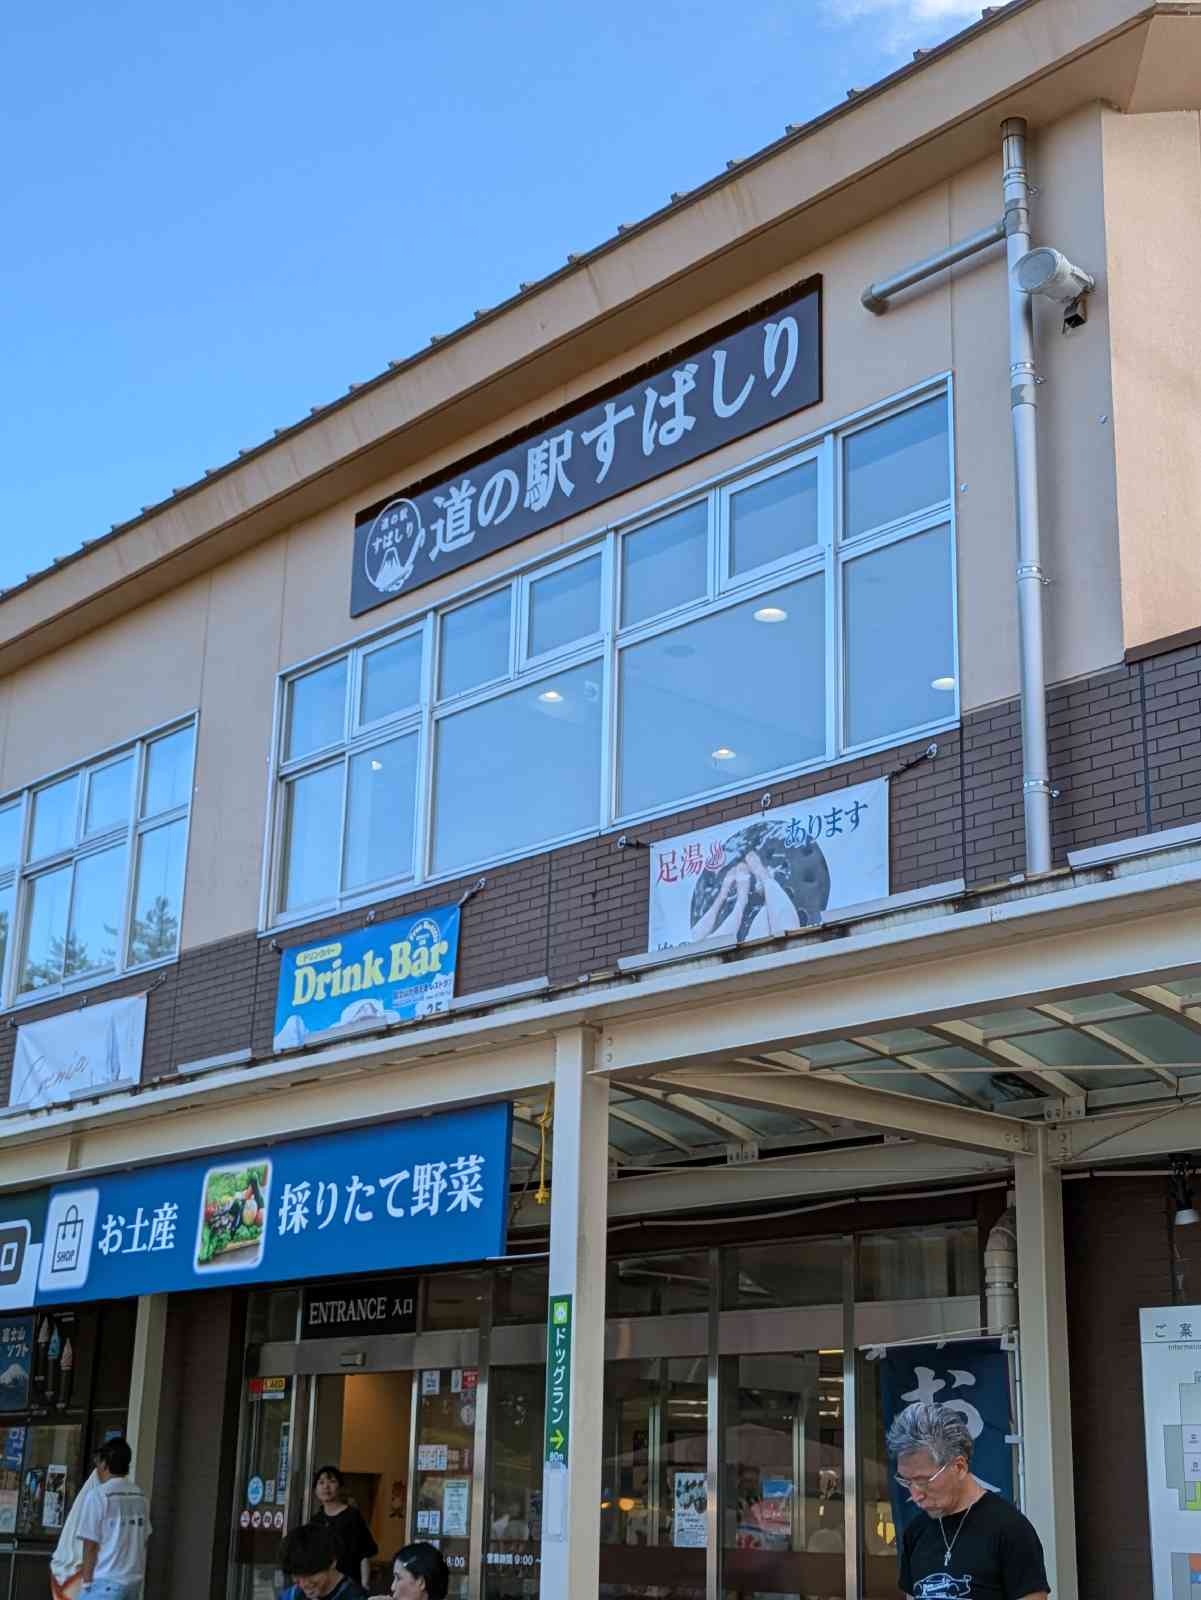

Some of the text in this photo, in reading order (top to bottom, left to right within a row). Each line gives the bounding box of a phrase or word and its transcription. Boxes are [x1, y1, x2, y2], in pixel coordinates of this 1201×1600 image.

[428, 315, 800, 562] 道の駅すばしり
[784, 800, 869, 849] あります
[656, 843, 704, 885] 足湯
[291, 948, 386, 1007] Drink
[387, 938, 449, 984] Bar
[277, 1153, 487, 1237] 採りたて野菜
[97, 1201, 180, 1256] お土産
[55, 1249, 76, 1264] SHOP
[308, 1296, 414, 1326] ENTRANCE 入口
[551, 1327, 567, 1425] ドッグラン
